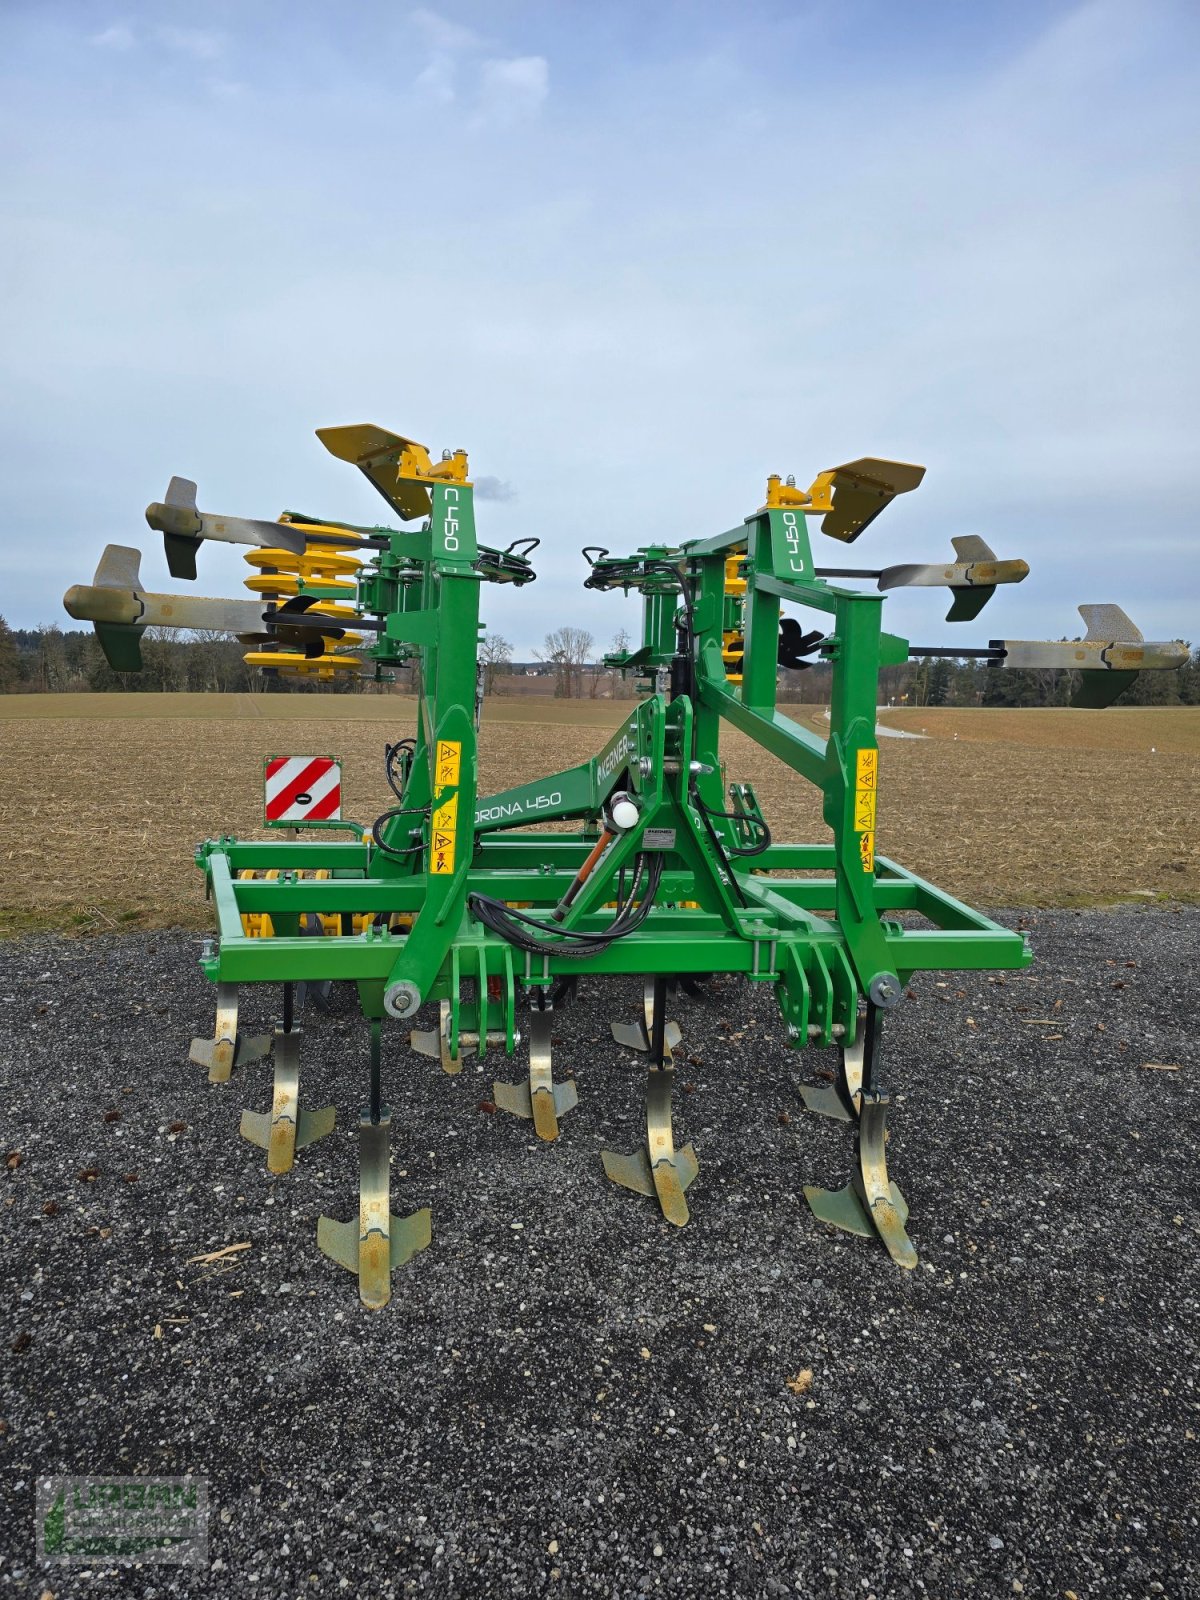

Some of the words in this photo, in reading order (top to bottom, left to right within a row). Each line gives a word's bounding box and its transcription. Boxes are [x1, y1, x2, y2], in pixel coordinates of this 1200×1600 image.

[445, 488, 459, 501] C
[444, 506, 459, 551] 450
[783, 512, 799, 554] 450
[790, 559, 804, 572] C
[602, 734, 628, 781] KERNER
[474, 802, 523, 823] ORONA
[526, 792, 561, 809] 450
